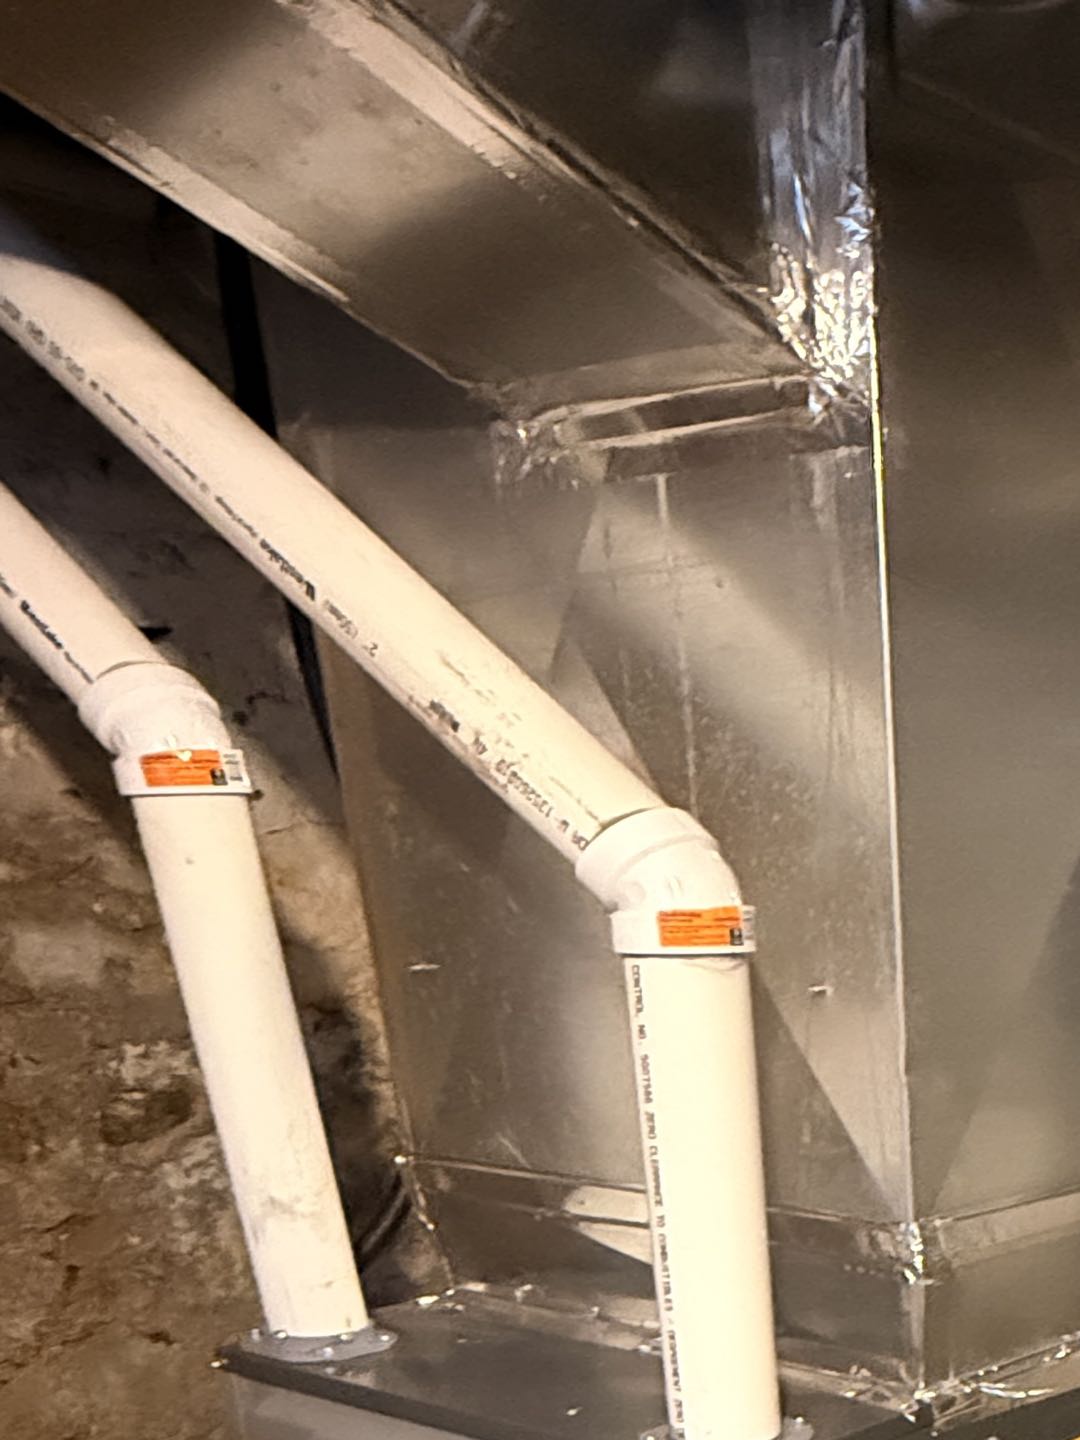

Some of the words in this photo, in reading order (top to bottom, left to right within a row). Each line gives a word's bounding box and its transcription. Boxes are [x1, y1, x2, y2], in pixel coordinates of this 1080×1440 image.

[632, 964, 644, 1017] CONTROL
[644, 1111, 657, 1140] ZERO
[649, 1145, 663, 1207] CLEARANCE
